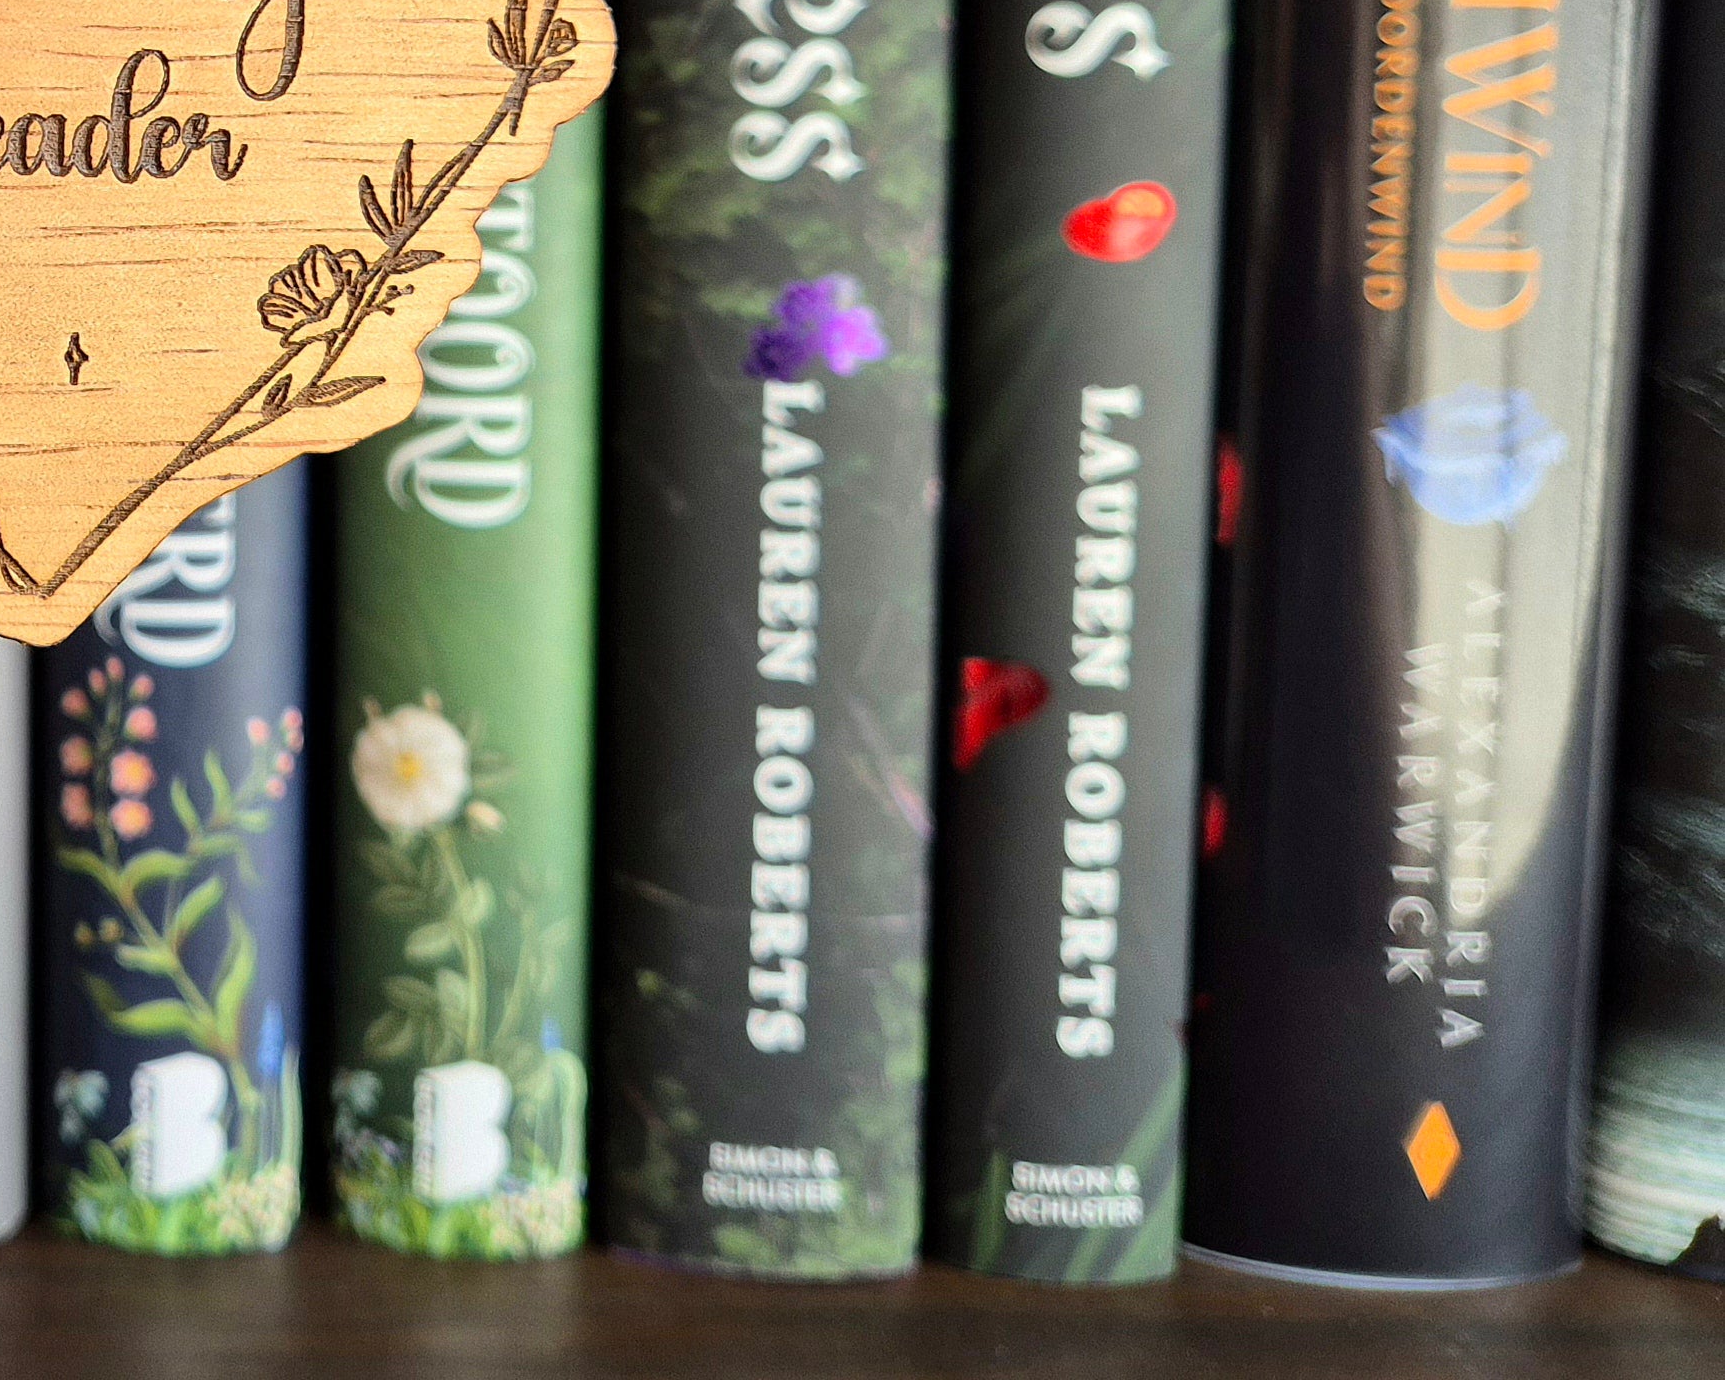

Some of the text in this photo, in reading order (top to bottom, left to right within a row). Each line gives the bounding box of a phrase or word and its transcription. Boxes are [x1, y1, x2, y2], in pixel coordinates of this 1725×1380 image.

[745, 380, 827, 1055] LAUREN ROBERTS
[1055, 384, 1143, 1059] LAUREN ROBERTS
[1385, 642, 1449, 986] WARWICK
[1440, 580, 1507, 1052] ALEXANDRIA
[703, 1170, 843, 1211] SCHUSTER
[709, 1141, 809, 1176] SIMON
[1005, 1190, 1143, 1228] SCHUSTER
[1012, 1161, 1114, 1195] SIMON
